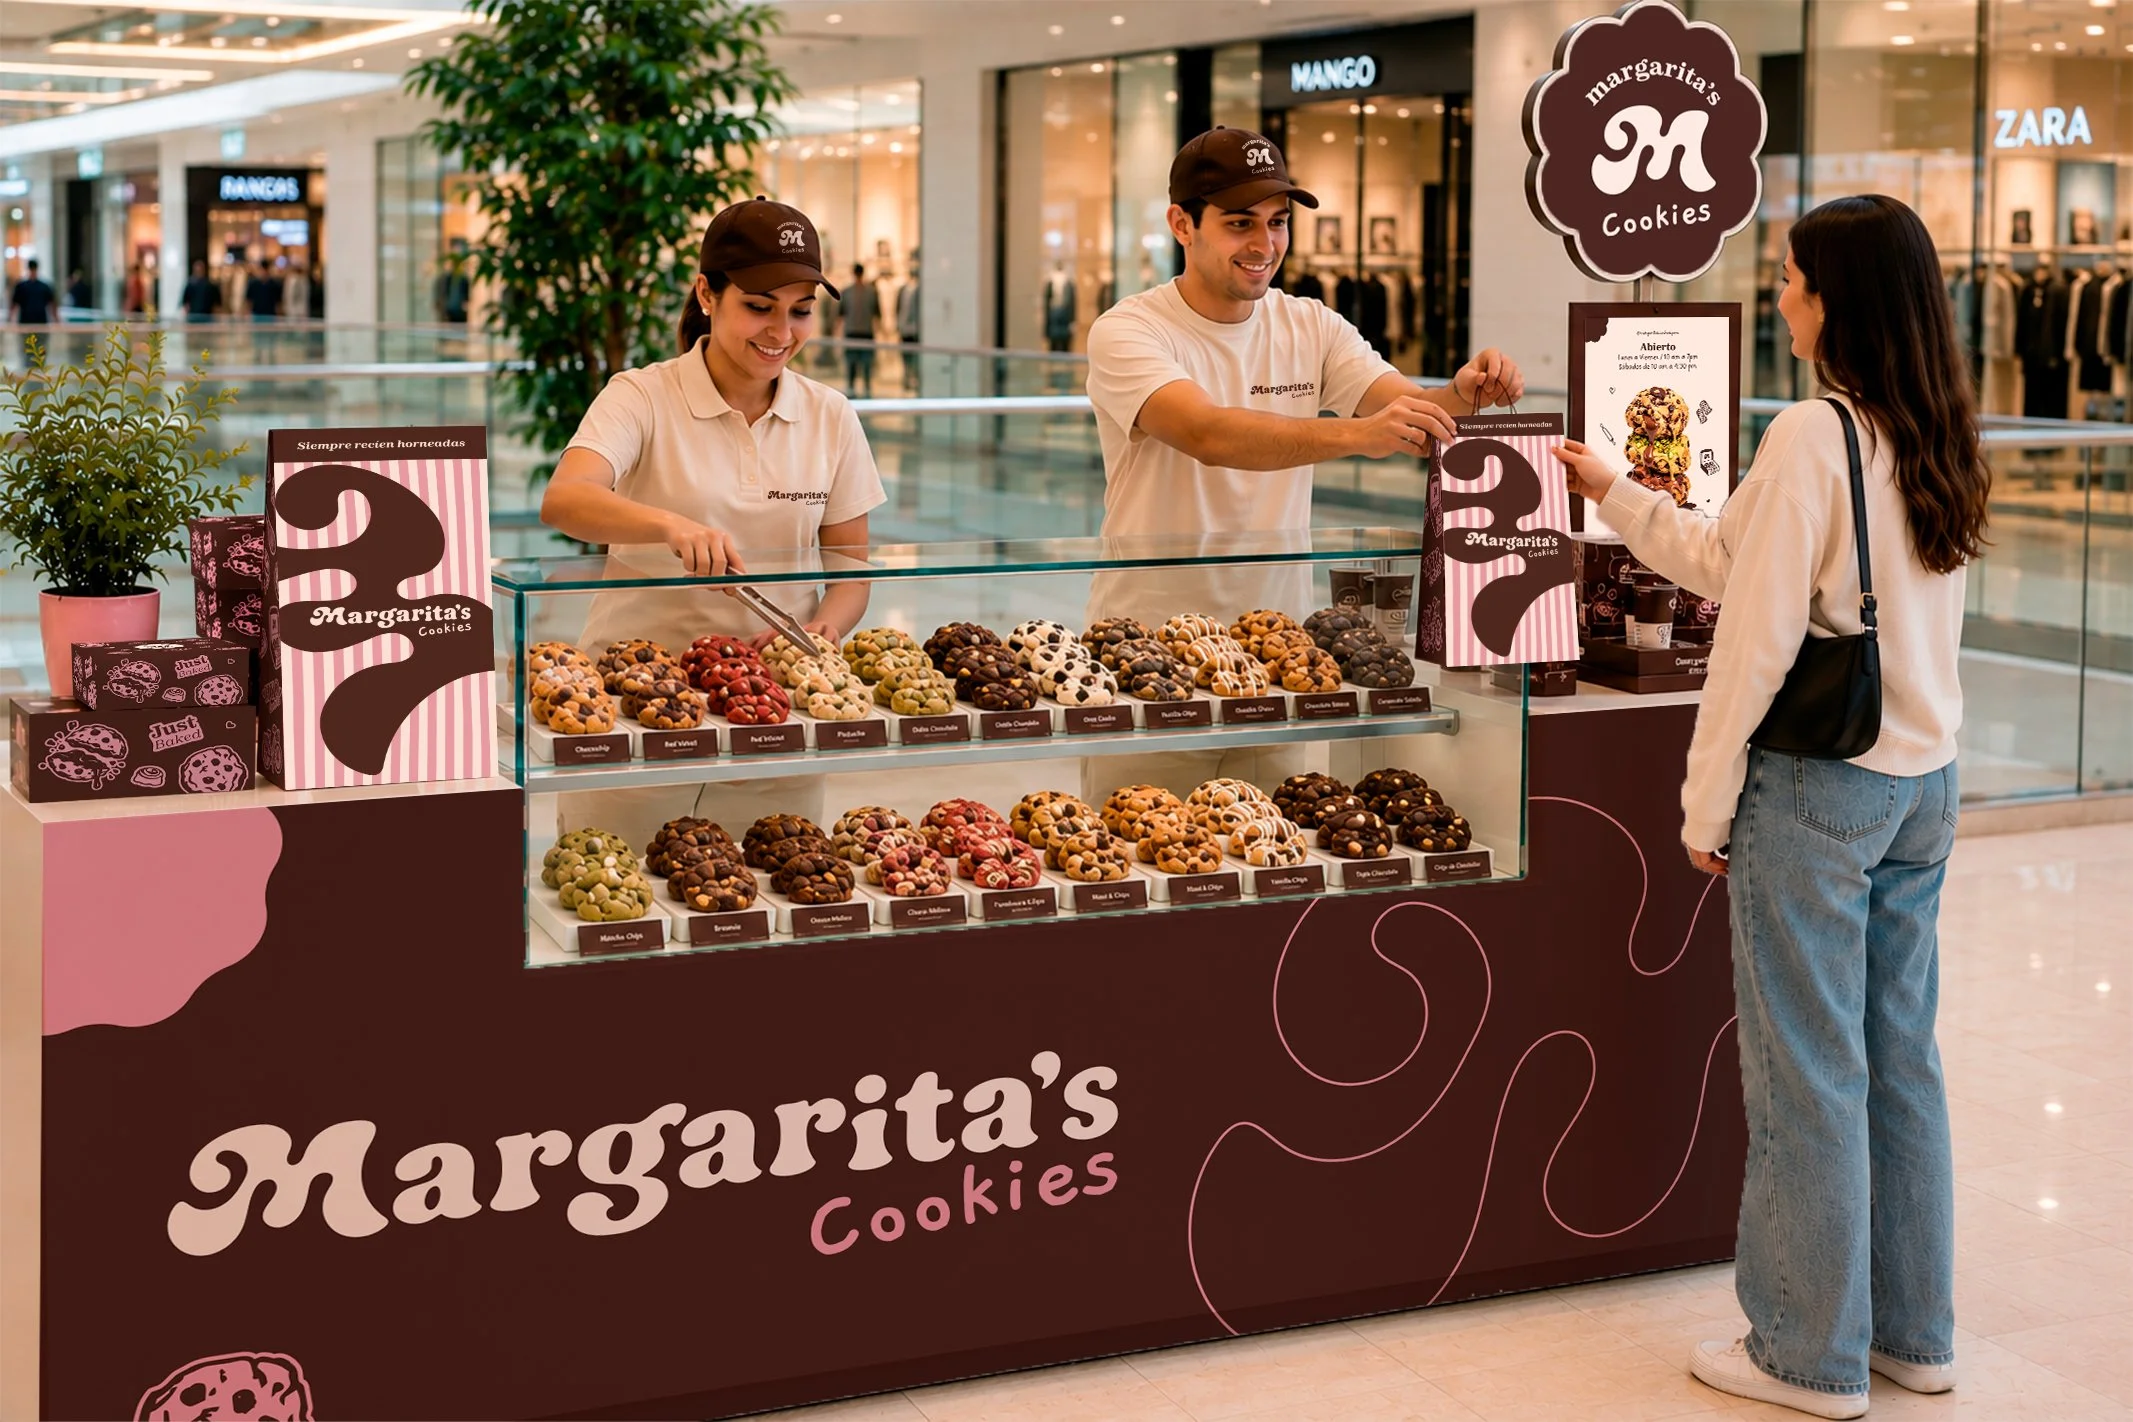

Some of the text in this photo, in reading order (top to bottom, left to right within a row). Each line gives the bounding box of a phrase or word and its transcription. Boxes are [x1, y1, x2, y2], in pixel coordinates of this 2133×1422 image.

[1291, 55, 1376, 92] MANGO
[1585, 58, 1721, 107] margarita's
[1993, 105, 2093, 149] ZARA
[1246, 148, 1275, 167] M
[1591, 105, 1716, 195] M
[1602, 203, 1711, 237] Cookies
[778, 229, 806, 247] M
[1640, 342, 1676, 351] Abierto
[1250, 382, 1314, 396] Margarita's
[1291, 390, 1315, 399] Cookies
[1459, 423, 1494, 431] Siempre
[296, 440, 352, 452] Siempre
[397, 438, 466, 448] horneadas
[767, 490, 828, 502] Margarita's
[1465, 531, 1559, 551] Margarita's
[1528, 548, 1559, 558] Cookies
[309, 604, 472, 629] Margarita's
[418, 622, 472, 637] Cookies
[176, 655, 208, 671] Just
[179, 663, 211, 678] Baked
[151, 716, 198, 739] Just
[155, 729, 201, 750] Baked
[626, 931, 644, 941] Chips
[167, 1050, 1119, 1257] Margarita's
[811, 1151, 1116, 1255] Cookies
